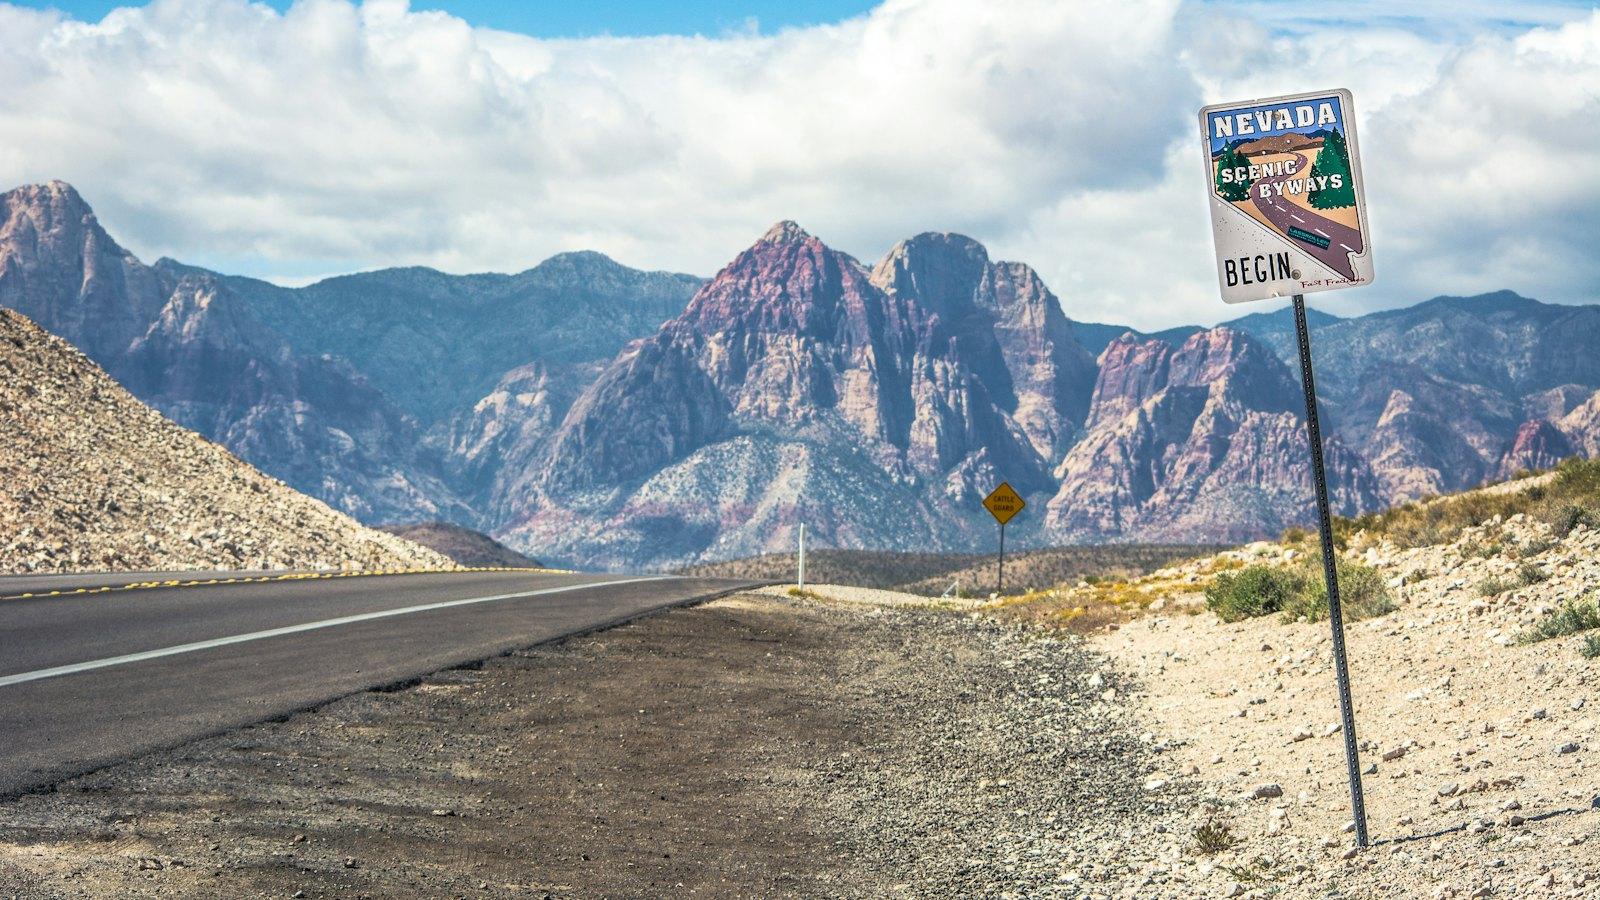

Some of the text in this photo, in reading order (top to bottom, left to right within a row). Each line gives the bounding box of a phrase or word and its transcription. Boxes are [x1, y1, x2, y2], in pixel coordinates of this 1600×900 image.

[1214, 102, 1337, 138] NEVADA
[1221, 160, 1298, 184] SCENIC
[1258, 174, 1343, 198] BYWAYS
[1225, 252, 1291, 287] BEGIN
[994, 495, 1014, 503] CATTLE
